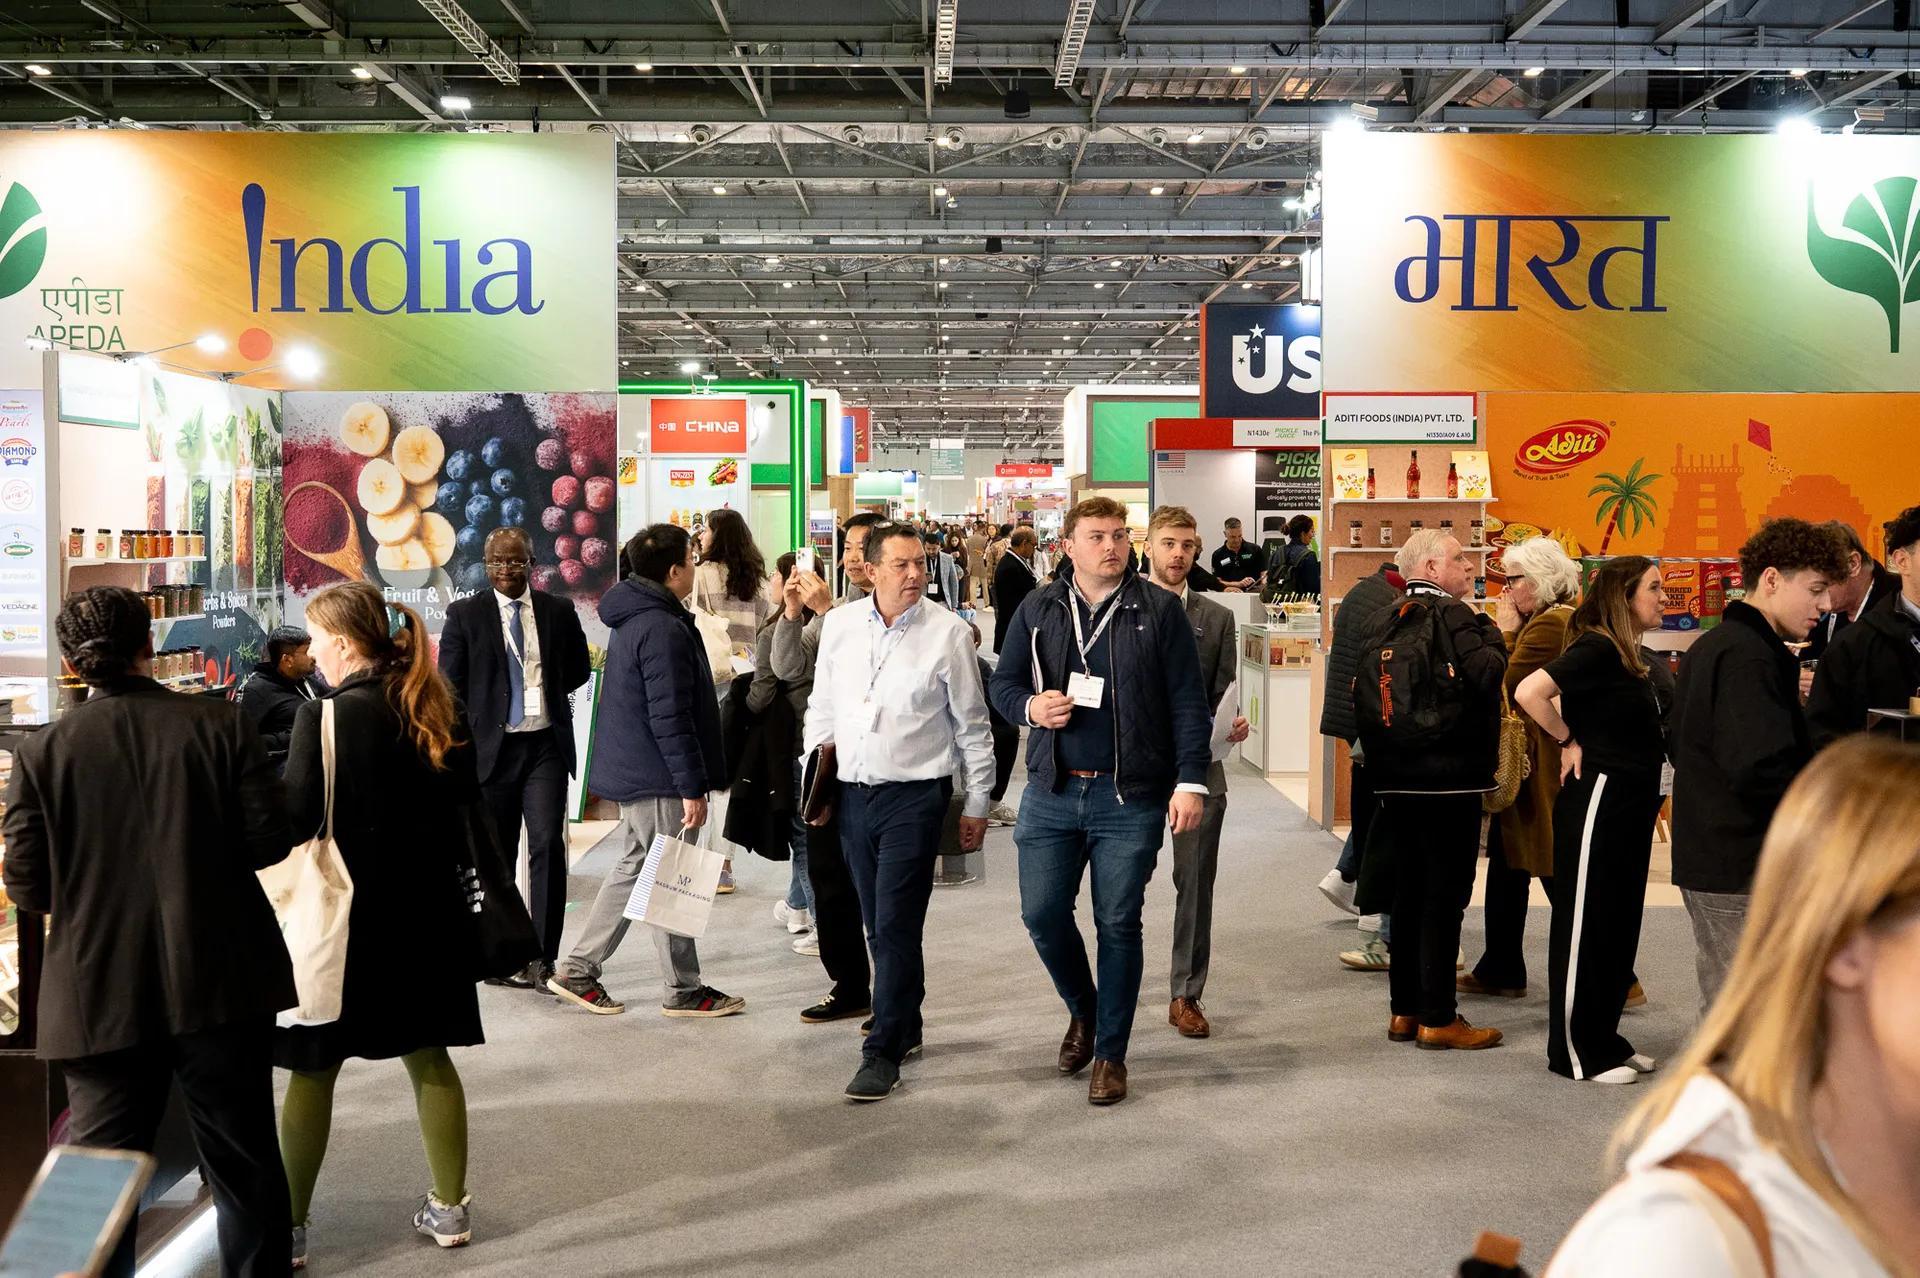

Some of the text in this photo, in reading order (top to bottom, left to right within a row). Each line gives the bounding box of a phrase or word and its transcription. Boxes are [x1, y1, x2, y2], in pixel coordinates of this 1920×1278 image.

[1394, 214, 1671, 313] भारत
[40, 276, 125, 322] एपीडा
[1334, 413, 1465, 424] ADITI FOODS (INDIA) PVT. LTD.
[1525, 431, 1598, 463] Aditi
[203, 592, 219, 612] erbs
[220, 591, 227, 610] &
[426, 586, 440, 603] &
[445, 585, 480, 603] Ve
